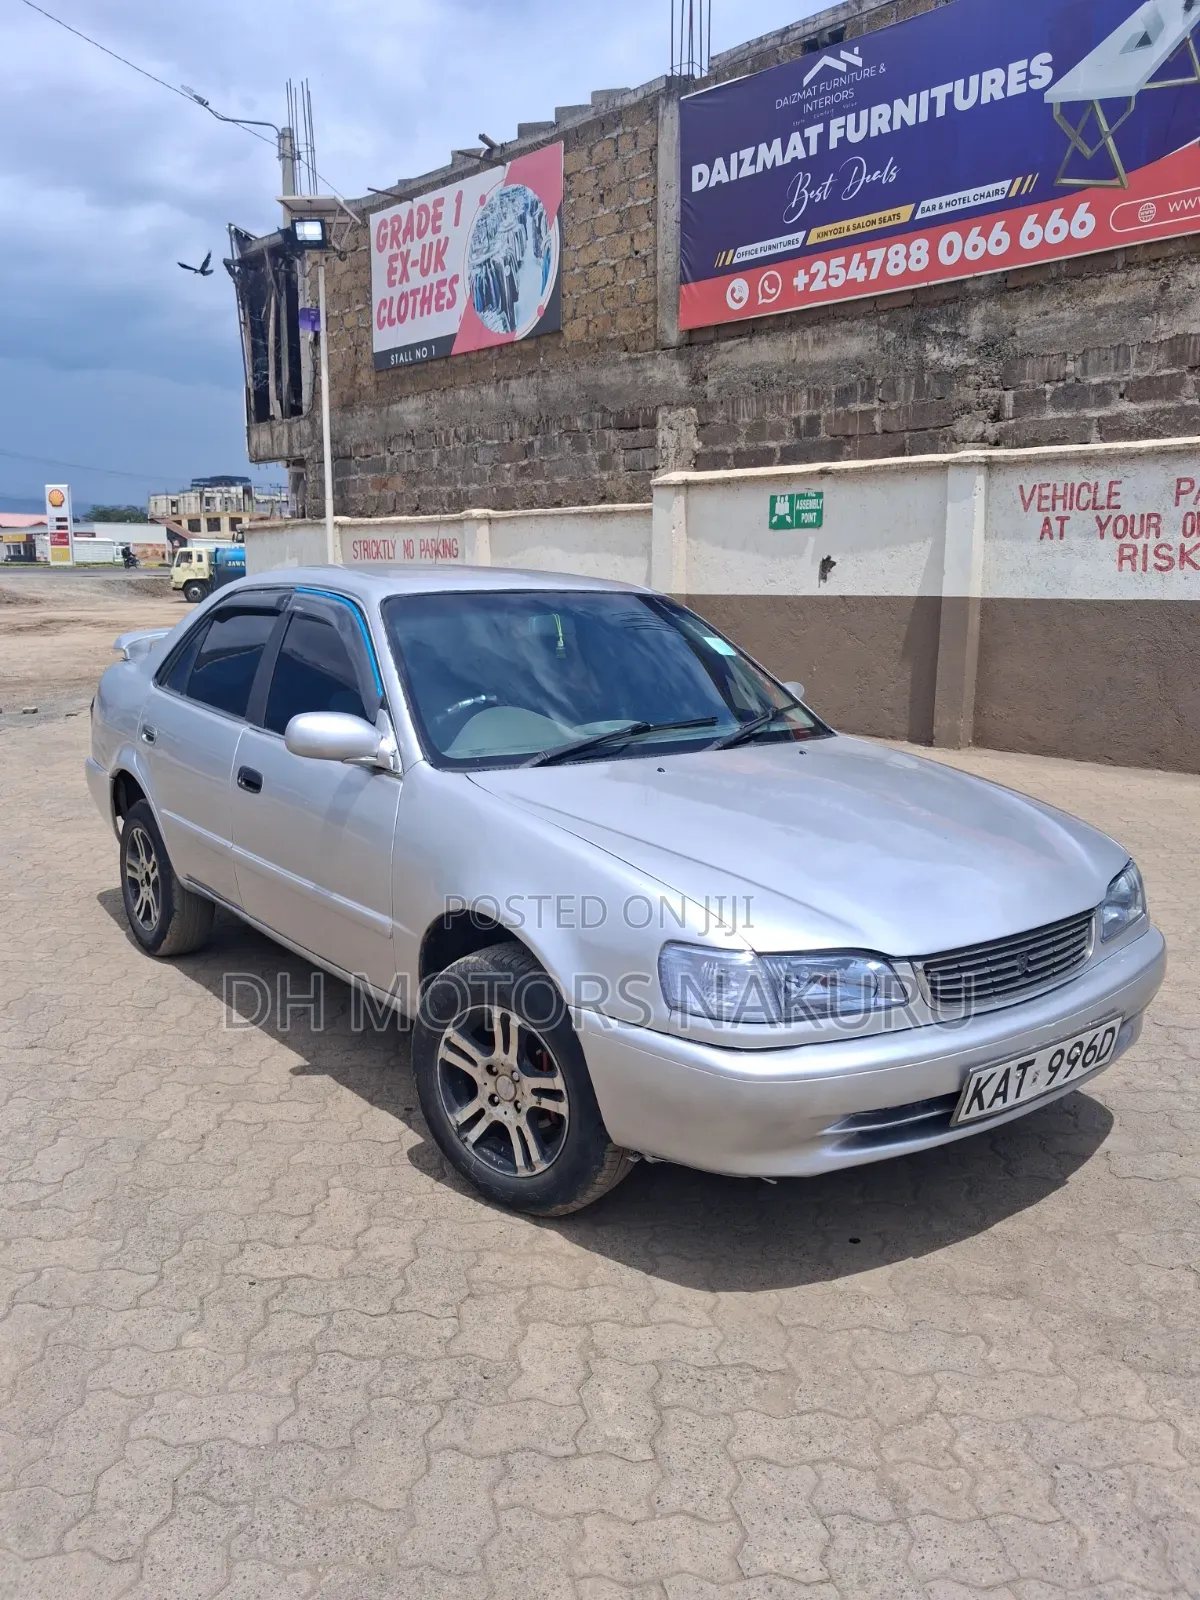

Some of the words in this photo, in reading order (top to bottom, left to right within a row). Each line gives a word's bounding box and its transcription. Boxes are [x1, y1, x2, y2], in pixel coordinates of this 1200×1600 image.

[775, 85, 818, 110] DAIZMAT
[819, 65, 877, 93] FURNITURE
[879, 63, 886, 74] &
[803, 88, 855, 114] INTERIORS
[691, 123, 824, 193] DAIZMAT
[828, 52, 1054, 150] FURNITURES
[783, 171, 838, 224] Best
[839, 156, 901, 201] Deals
[920, 204, 937, 215] BAR
[938, 202, 944, 210] &
[944, 195, 972, 209] HOTEL
[973, 186, 1006, 202] CHAIRS
[1168, 196, 1200, 213] ww
[375, 196, 445, 254] GRADE
[453, 189, 464, 227] 1
[816, 225, 845, 240] KINYOZI
[846, 224, 851, 232] &
[851, 218, 877, 232] SALON
[878, 212, 901, 225] SEATS
[736, 247, 759, 259] OFFICE
[759, 237, 800, 253] FURNITURES
[793, 238, 930, 293] +254788
[937, 220, 1011, 266] 066
[1019, 201, 1097, 250] 666
[386, 236, 449, 289] EX-UK
[376, 273, 460, 331] CLOTHES
[390, 348, 413, 365] STALL
[415, 346, 428, 360] NO
[432, 344, 436, 356] 1
[796, 498, 823, 510] ASSEMBLY
[1018, 480, 1123, 513] VEHICLE
[801, 512, 817, 523] POINT
[1039, 515, 1071, 541] AT
[1095, 512, 1163, 540] YOUR
[352, 539, 397, 561] STRICKTLY
[403, 538, 415, 560] NO
[419, 537, 459, 559] PARKING
[1117, 542, 1200, 573] RISK
[964, 1058, 1037, 1115] KAT
[1045, 1026, 1116, 1087] 996D
